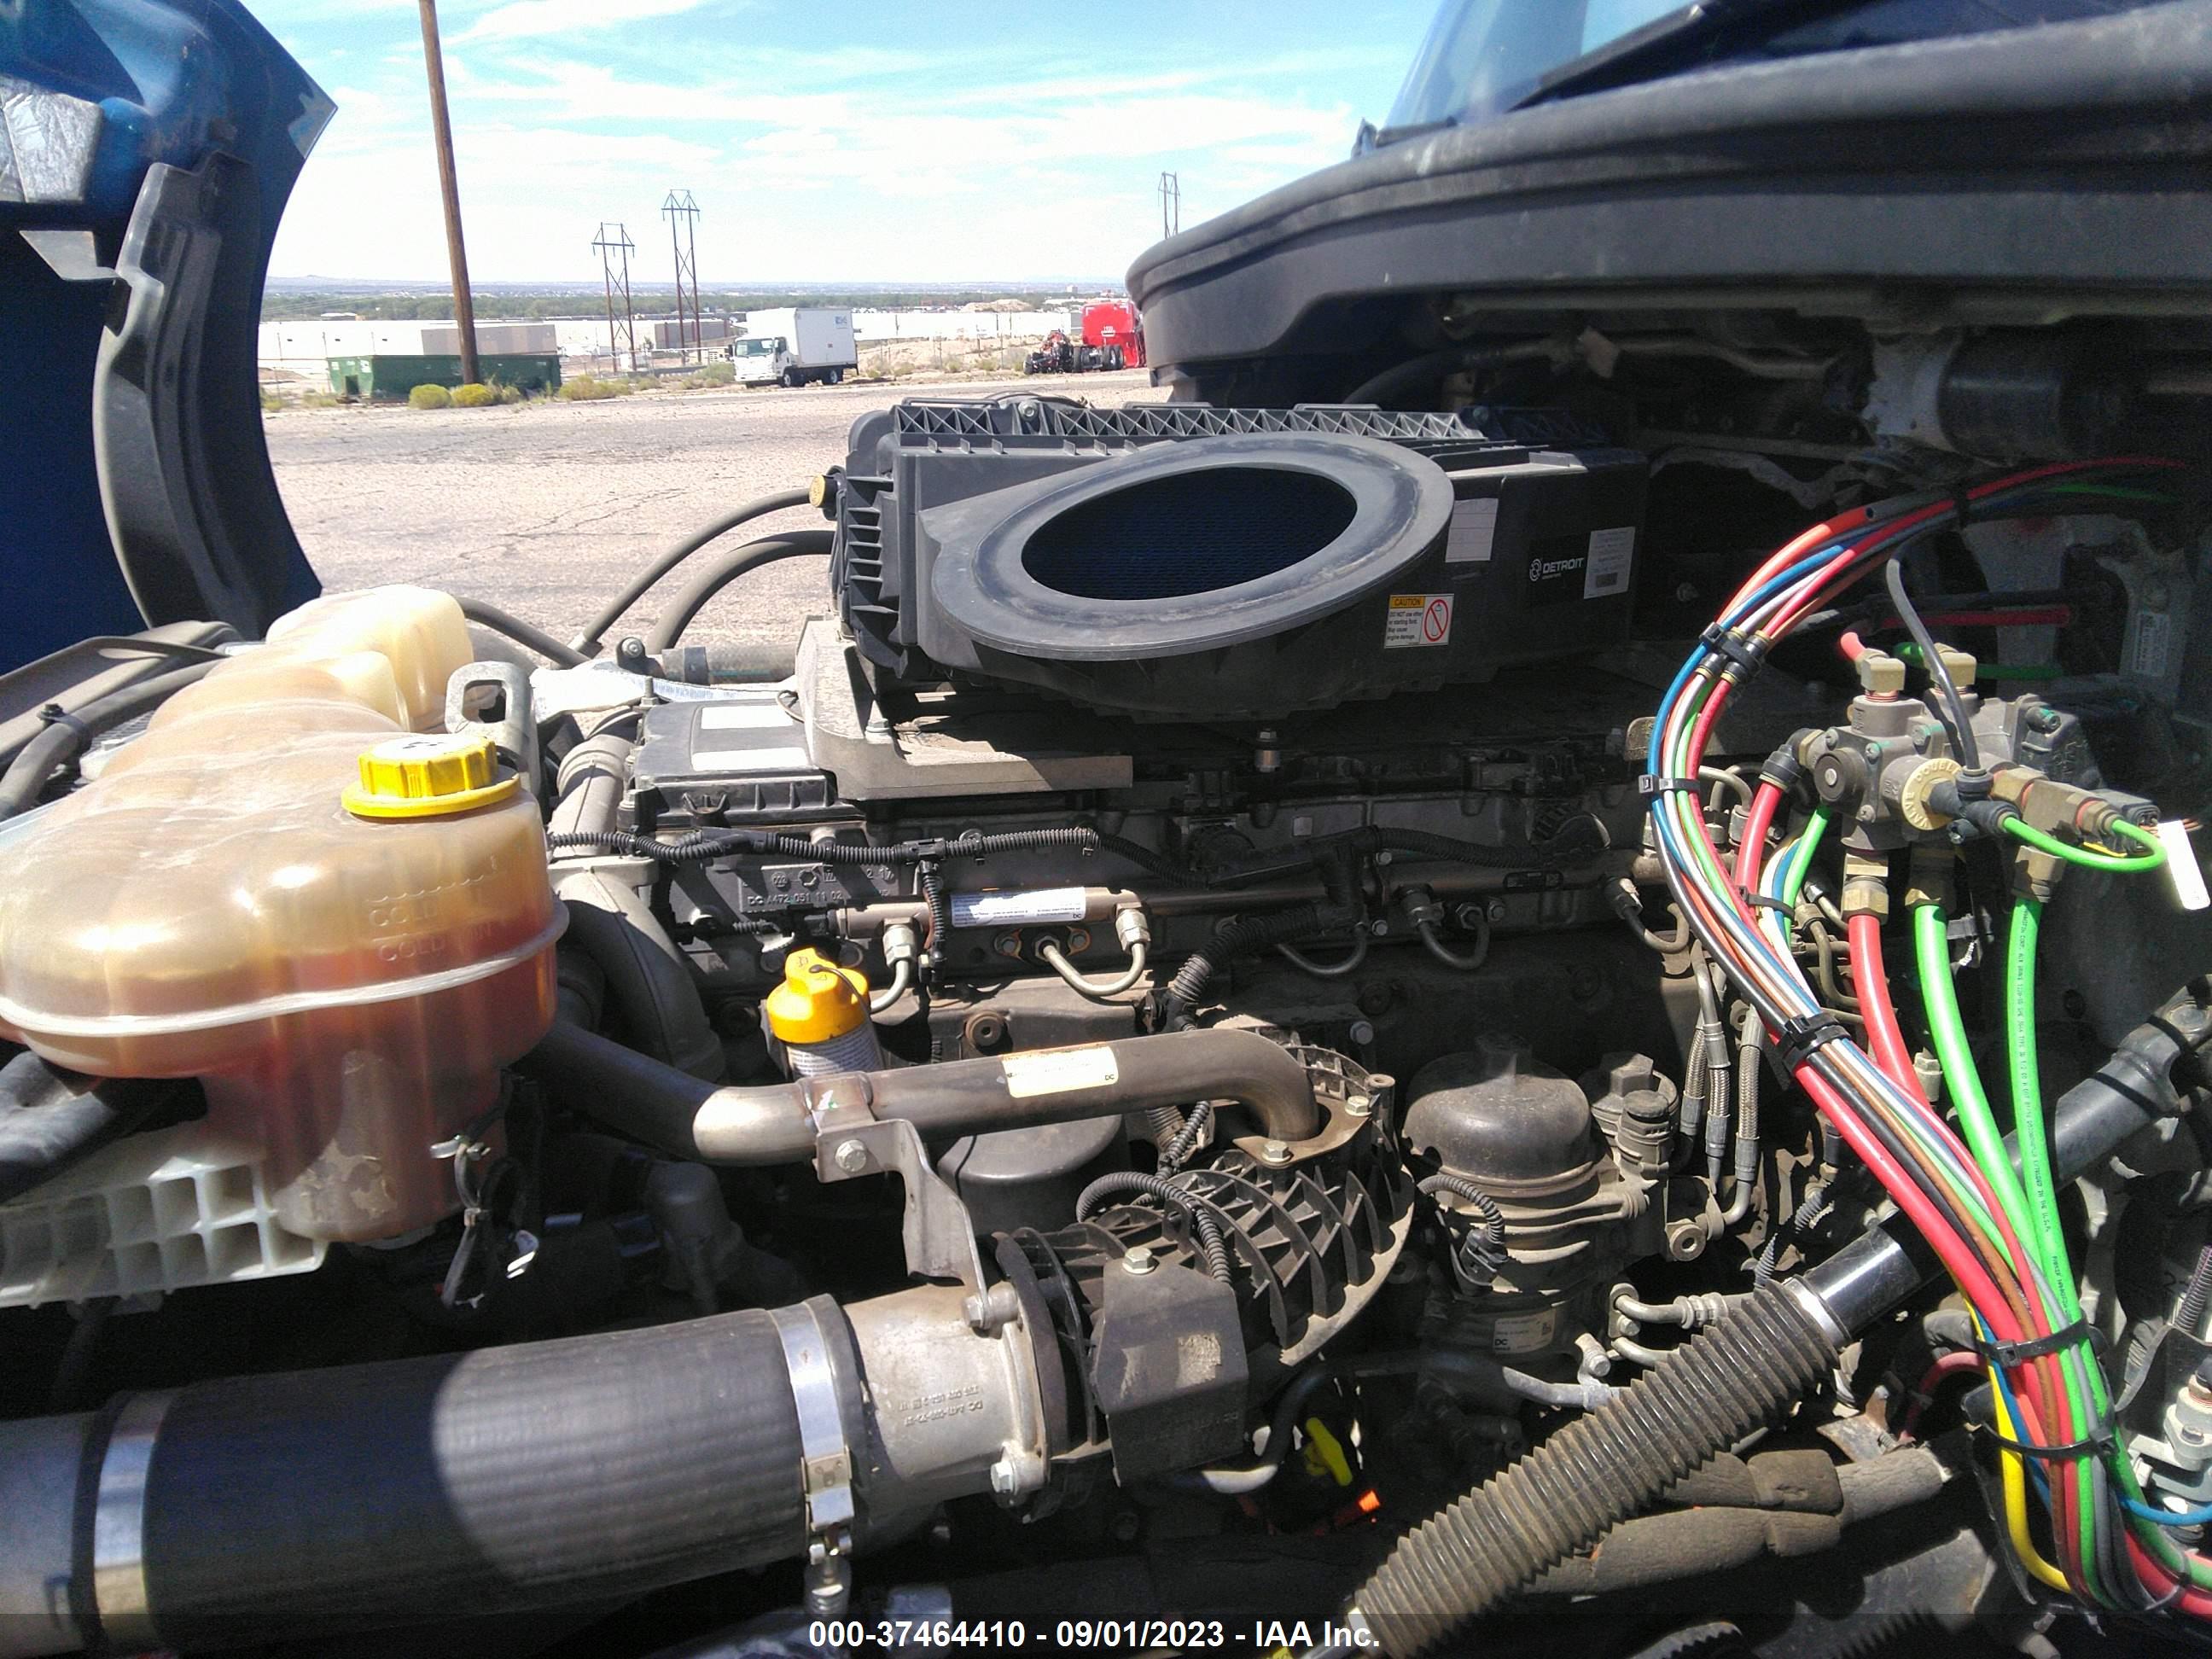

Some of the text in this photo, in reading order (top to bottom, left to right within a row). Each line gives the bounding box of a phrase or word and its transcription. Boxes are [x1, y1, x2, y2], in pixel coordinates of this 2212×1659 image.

[1542, 557, 1585, 574] DETROIT
[747, 895, 764, 905] DC
[793, 892, 811, 902] 051
[830, 890, 844, 900] 02
[379, 934, 445, 962] COLD
